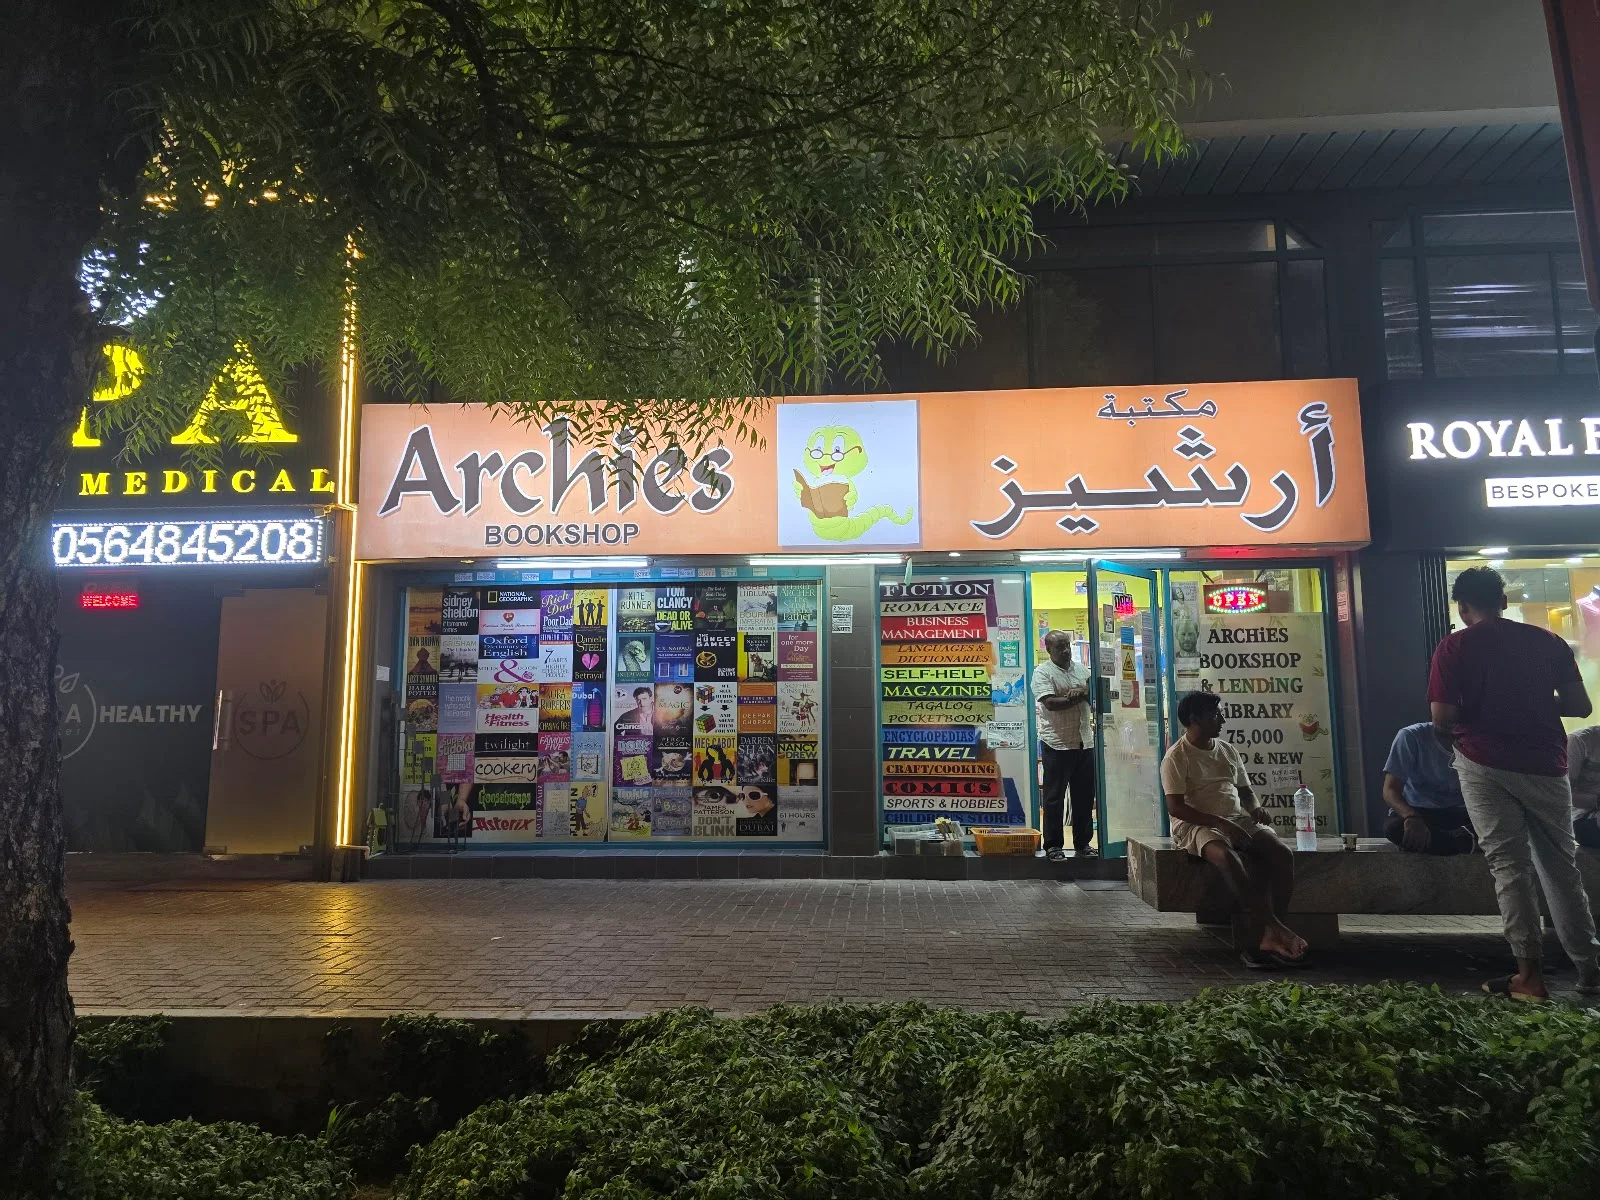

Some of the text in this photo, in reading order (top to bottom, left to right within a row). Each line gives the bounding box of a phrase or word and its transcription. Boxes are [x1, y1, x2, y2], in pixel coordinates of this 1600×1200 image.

[1096, 389, 1217, 426] مكتبة
[1407, 417, 1574, 460] ROYAL
[378, 414, 733, 516] Archies
[970, 401, 1336, 538] أرشيز
[79, 469, 335, 496] MEDICAL
[1492, 484, 1599, 499] BESPOKE
[484, 523, 640, 546] BOOKSHOP
[52, 522, 313, 564] 0564845208
[628, 592, 645, 600] KITE
[666, 586, 686, 598] TOM
[883, 582, 993, 598] FICTION
[82, 595, 138, 607] WELCOME
[443, 595, 472, 608] sidney
[542, 590, 568, 607] Rich
[658, 597, 693, 609] CLANCY
[1212, 593, 1260, 607] OPEN
[620, 600, 652, 610] RUNNER
[882, 602, 984, 613] ROMANCE
[443, 606, 478, 618] sheldon
[656, 610, 690, 620] DEAD OR
[542, 616, 573, 626] Poor Dad
[671, 620, 694, 630] ALIVE
[907, 616, 969, 627] BUSINESS
[882, 628, 984, 639] MANAGEMENT
[420, 635, 440, 647] BROWN
[484, 636, 528, 644] Oxford
[484, 648, 528, 658] English
[897, 644, 985, 653] LANGUAGES &
[544, 649, 554, 664] 7
[898, 655, 990, 664] DICTIONARIES
[1200, 652, 1302, 669] BOOKSHOP
[494, 659, 534, 684] &
[574, 672, 604, 680] Betrayal
[884, 669, 985, 680] SELF-HELP
[408, 674, 418, 684] LOST
[884, 685, 992, 697] MAGAZINES
[1201, 678, 1213, 693] &
[572, 691, 595, 700] Dubai
[540, 699, 570, 711] ROBERTS
[907, 701, 974, 712] TAGALOG
[100, 704, 202, 723] HEALTHY
[889, 713, 993, 724] POCKETBOOKS
[240, 709, 301, 736] SPA
[540, 736, 570, 745] FAMOUS
[695, 737, 736, 748] MEG CABOT
[740, 736, 774, 744] DARREN
[883, 730, 975, 743] ENCYCLOPEDIAS
[1226, 729, 1284, 748] 75,000
[484, 738, 530, 750] twilight
[738, 745, 776, 755] SHAN
[778, 744, 817, 752] NANCY
[888, 747, 976, 760] TRAVEL
[1253, 752, 1265, 765] &
[1268, 752, 1304, 765] NEW
[475, 761, 536, 782] cookery
[886, 764, 995, 775] CRAFT/COOKING
[885, 782, 992, 794] COMICS
[478, 785, 532, 810] Goosebumps
[664, 801, 687, 812] Best
[887, 799, 1005, 809] SPORTS & HOBBIES
[570, 788, 578, 836] TINTIN
[968, 812, 1026, 824] STORIES
[472, 817, 536, 832] Asterix
[698, 816, 731, 825] DON'T
[694, 825, 736, 836] BLINK
